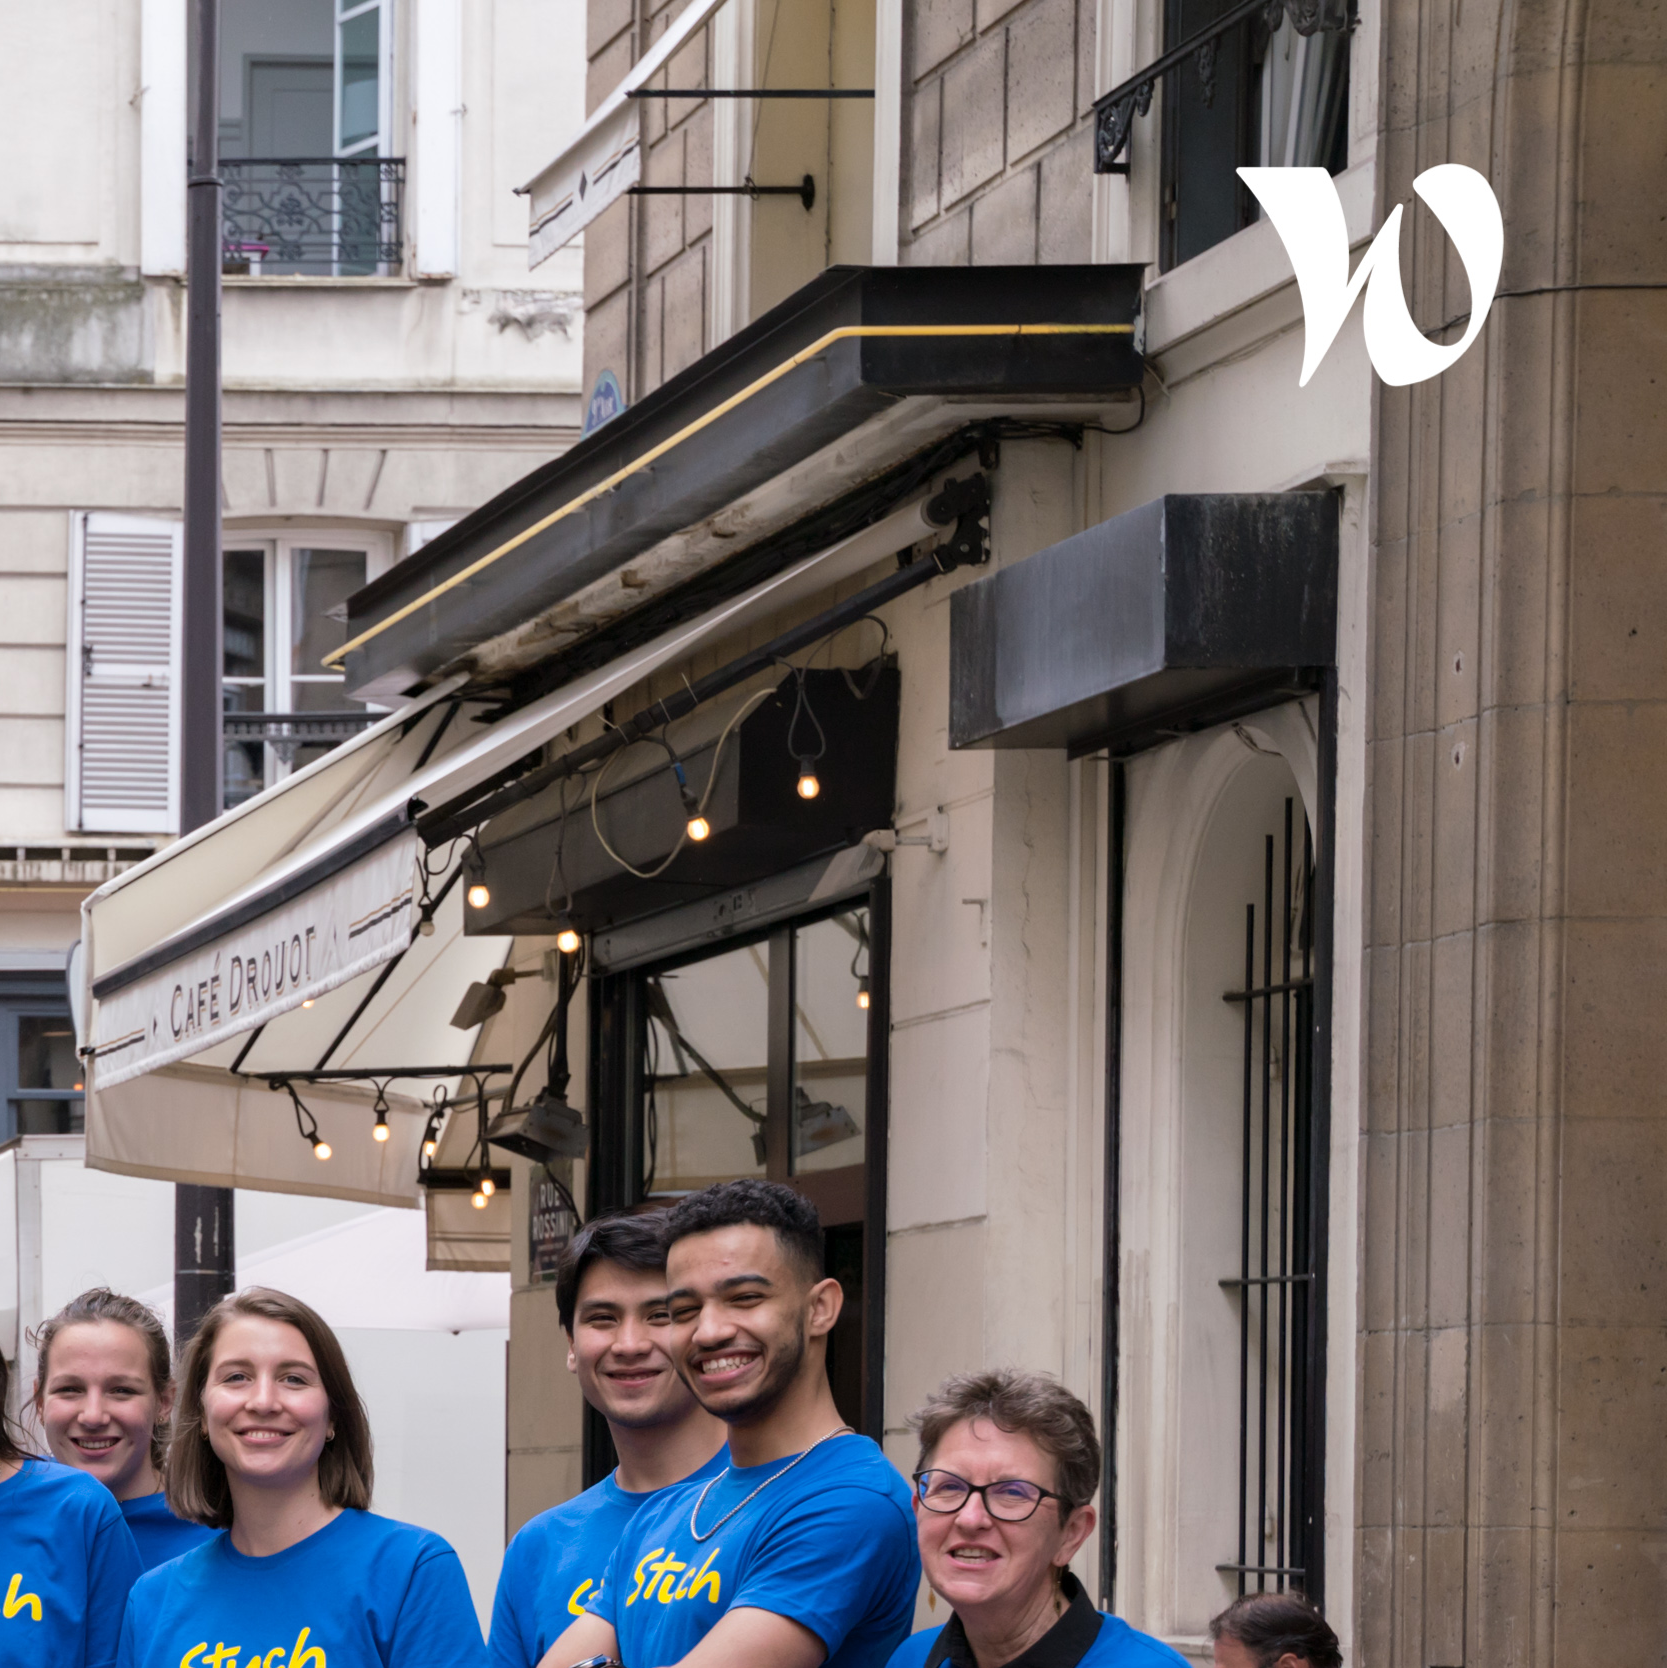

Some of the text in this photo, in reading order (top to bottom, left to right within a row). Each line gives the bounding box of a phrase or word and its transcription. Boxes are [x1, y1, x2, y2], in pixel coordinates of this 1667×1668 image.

[170, 926, 316, 1042] CAFÉ DROUOT
[540, 1182, 561, 1209] RUE
